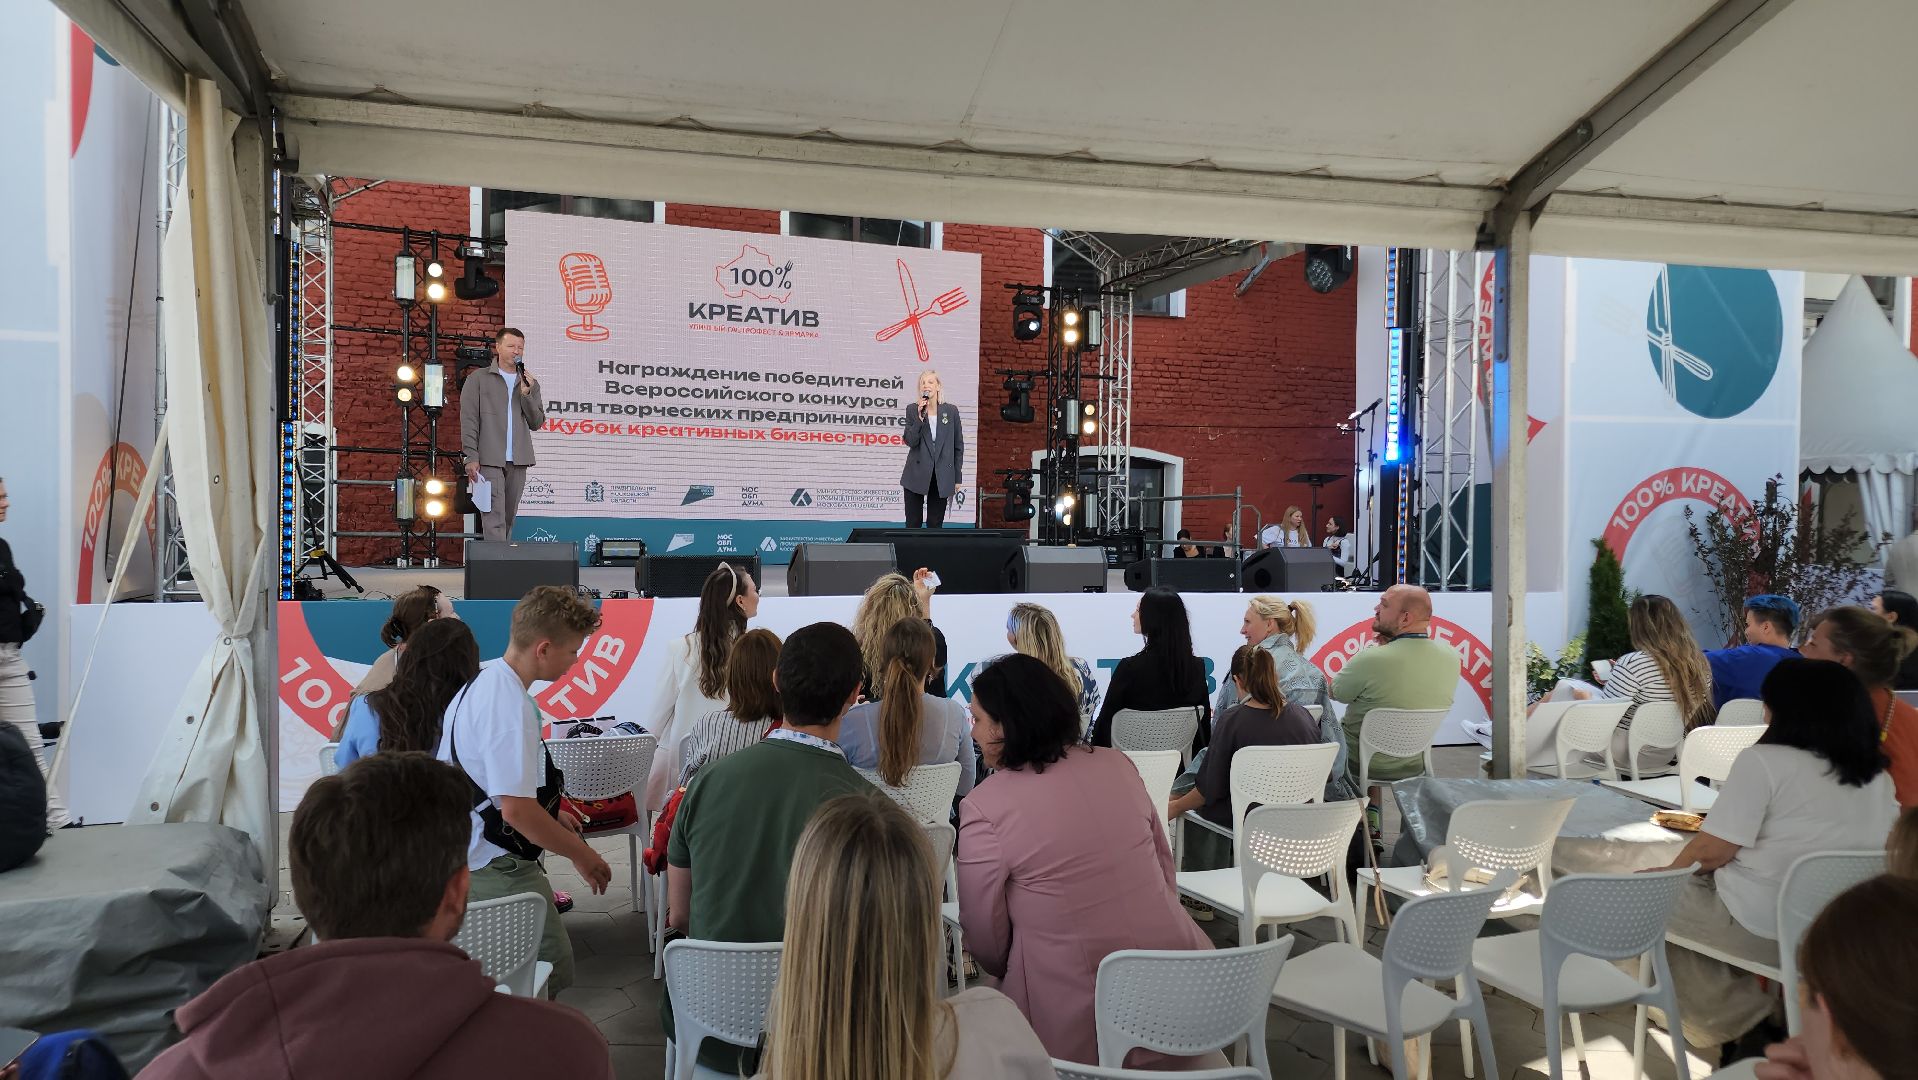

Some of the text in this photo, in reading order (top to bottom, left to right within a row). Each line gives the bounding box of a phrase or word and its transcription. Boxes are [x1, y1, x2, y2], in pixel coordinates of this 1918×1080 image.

[730, 259, 794, 290] 100%
[688, 302, 820, 328] КРЕАТИВ
[598, 360, 904, 390] Награждение победителей
[605, 380, 898, 409] Всероссийского конкурса
[545, 400, 907, 428] для творческих предпринимате
[627, 423, 766, 440] креативных
[1612, 475, 1675, 530] 100%
